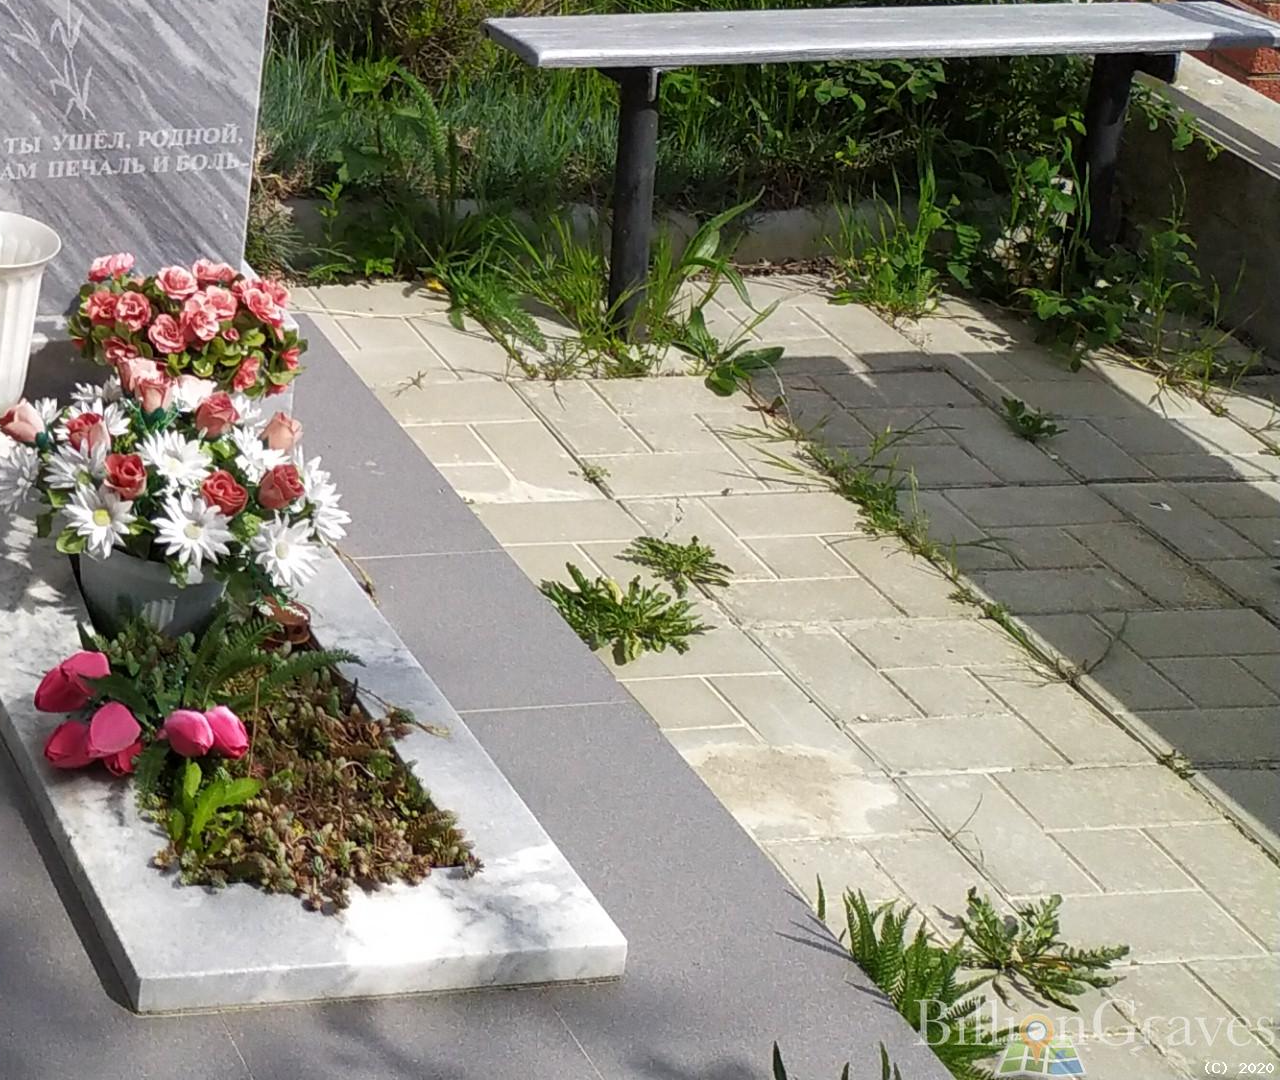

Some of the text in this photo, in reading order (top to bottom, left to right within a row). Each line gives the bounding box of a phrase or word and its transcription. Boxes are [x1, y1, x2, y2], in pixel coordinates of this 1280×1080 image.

[4, 136, 41, 155] ТЫ
[47, 157, 145, 178] ПЕЧАЛЬ
[153, 155, 170, 173] И
